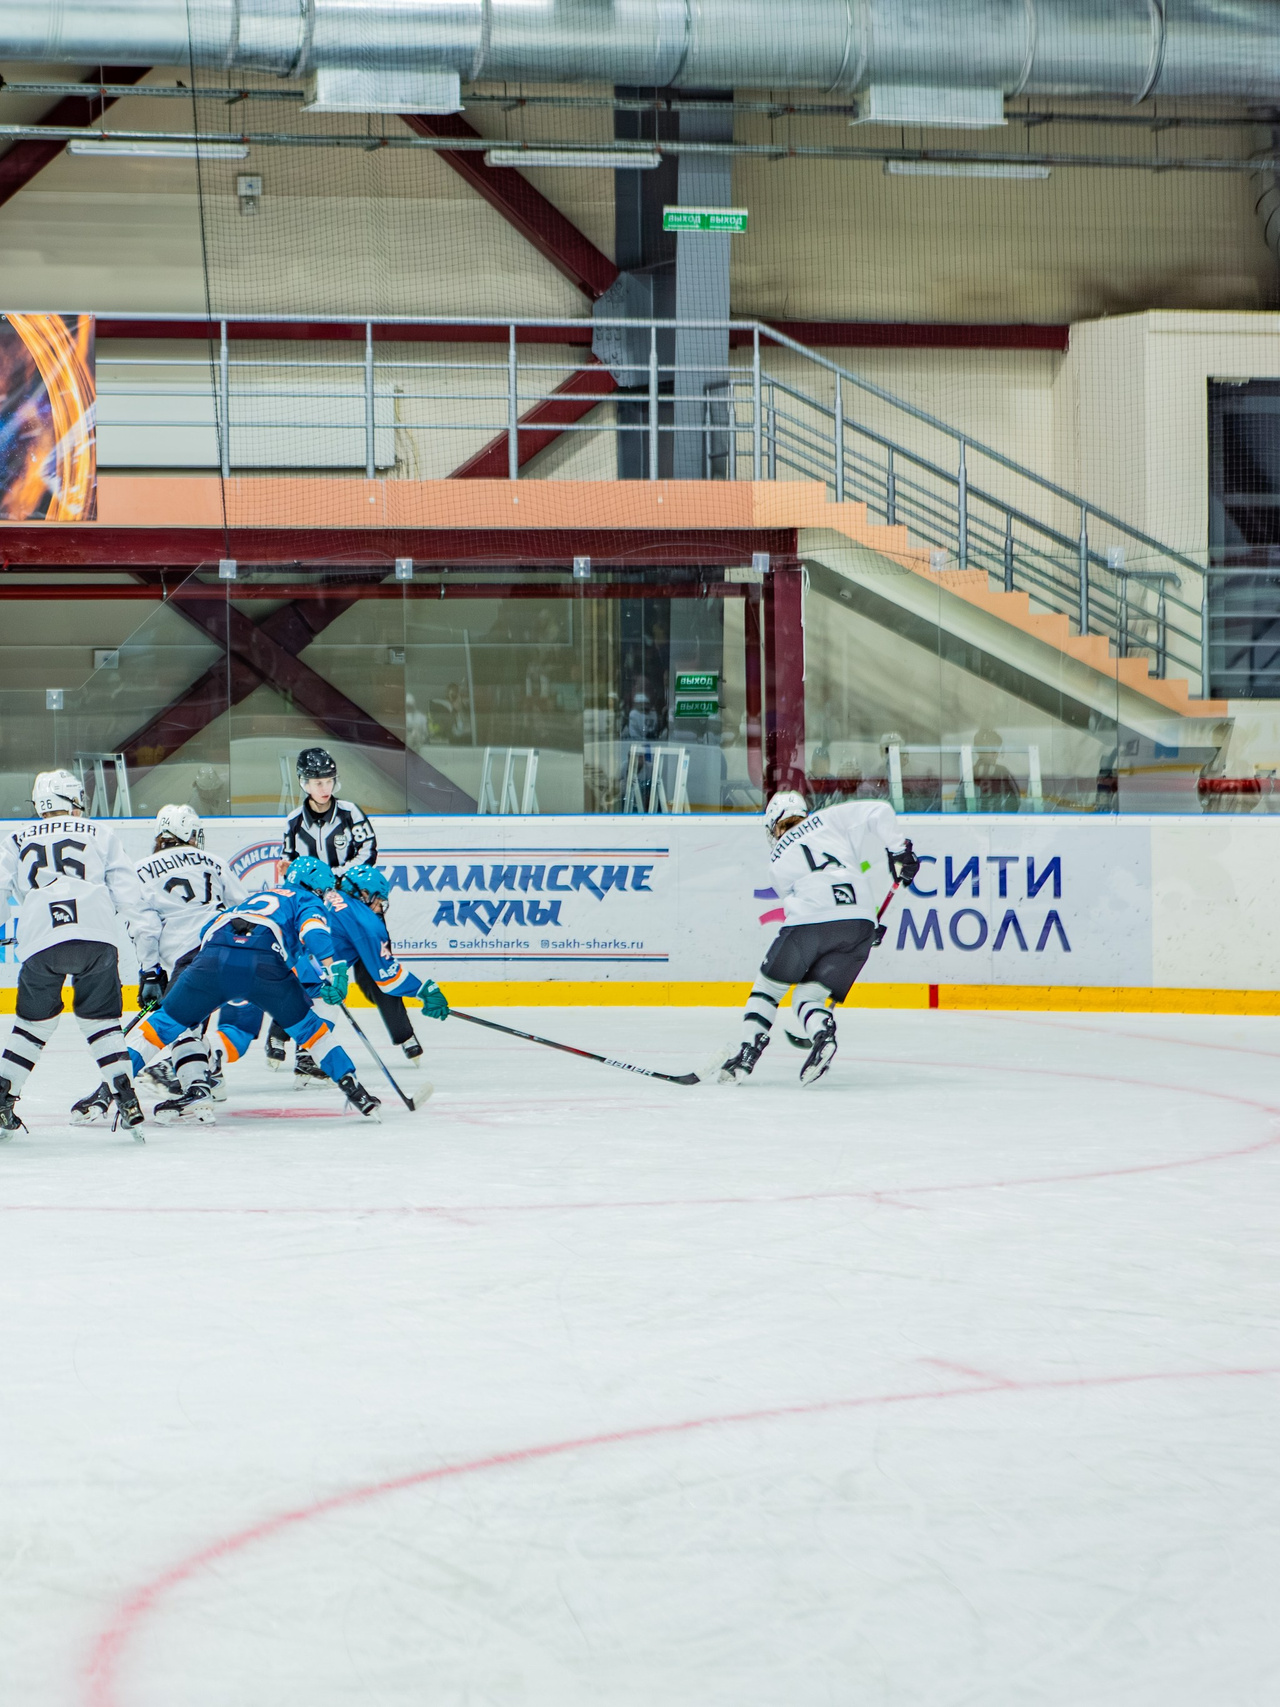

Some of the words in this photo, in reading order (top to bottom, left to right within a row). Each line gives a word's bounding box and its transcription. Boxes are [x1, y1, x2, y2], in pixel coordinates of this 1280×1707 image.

[668, 214, 701, 225] ВЫХОД
[709, 216, 742, 226] ВЫХОД
[680, 676, 713, 686] ВЫХОД
[40, 799, 53, 811] 26
[160, 816, 171, 827] 34
[351, 823, 375, 843] 81
[19, 838, 87, 889] 26
[231, 845, 283, 877] ЛИНСК
[375, 864, 654, 902] АХАЛИНСКИЕ
[908, 855, 1062, 899] СИТИ
[431, 899, 563, 937] АКУЛЫ
[895, 908, 1071, 953] МОЛЛ
[459, 938, 530, 950] sakhsharks
[551, 939, 644, 950] sakh-sharks.ru
